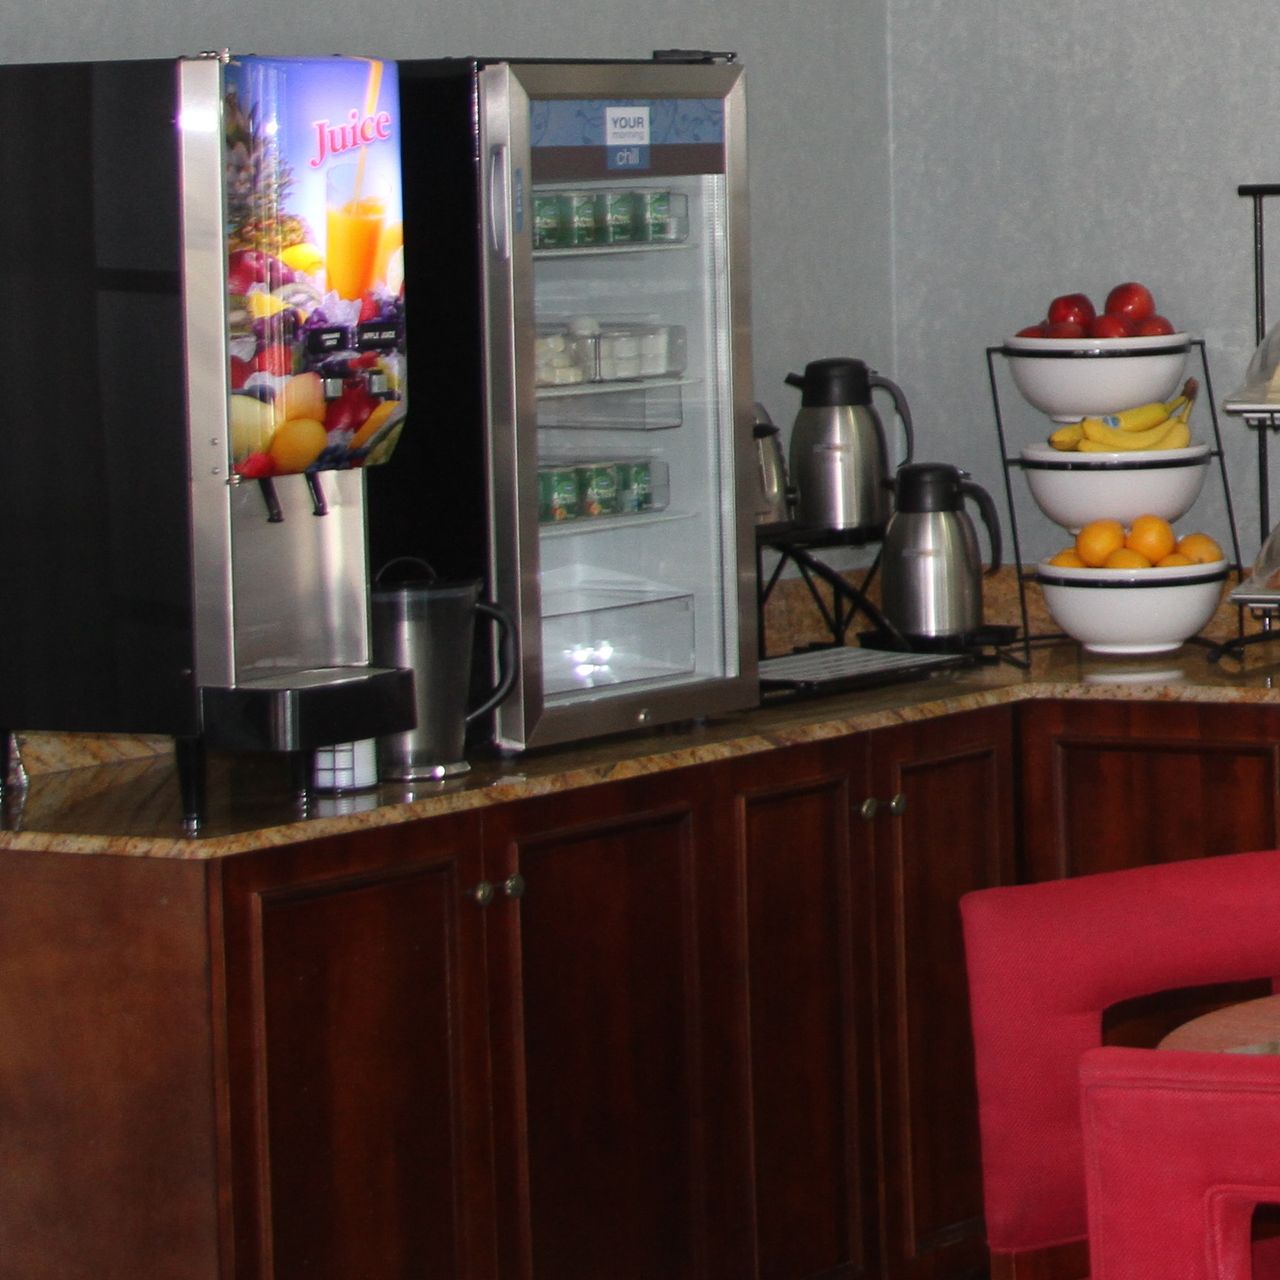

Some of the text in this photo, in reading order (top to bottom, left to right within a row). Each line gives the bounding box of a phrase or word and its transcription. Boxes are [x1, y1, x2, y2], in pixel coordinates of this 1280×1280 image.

[612, 116, 644, 129] YOUR
[309, 109, 391, 168] Juice
[616, 147, 640, 165] chill
